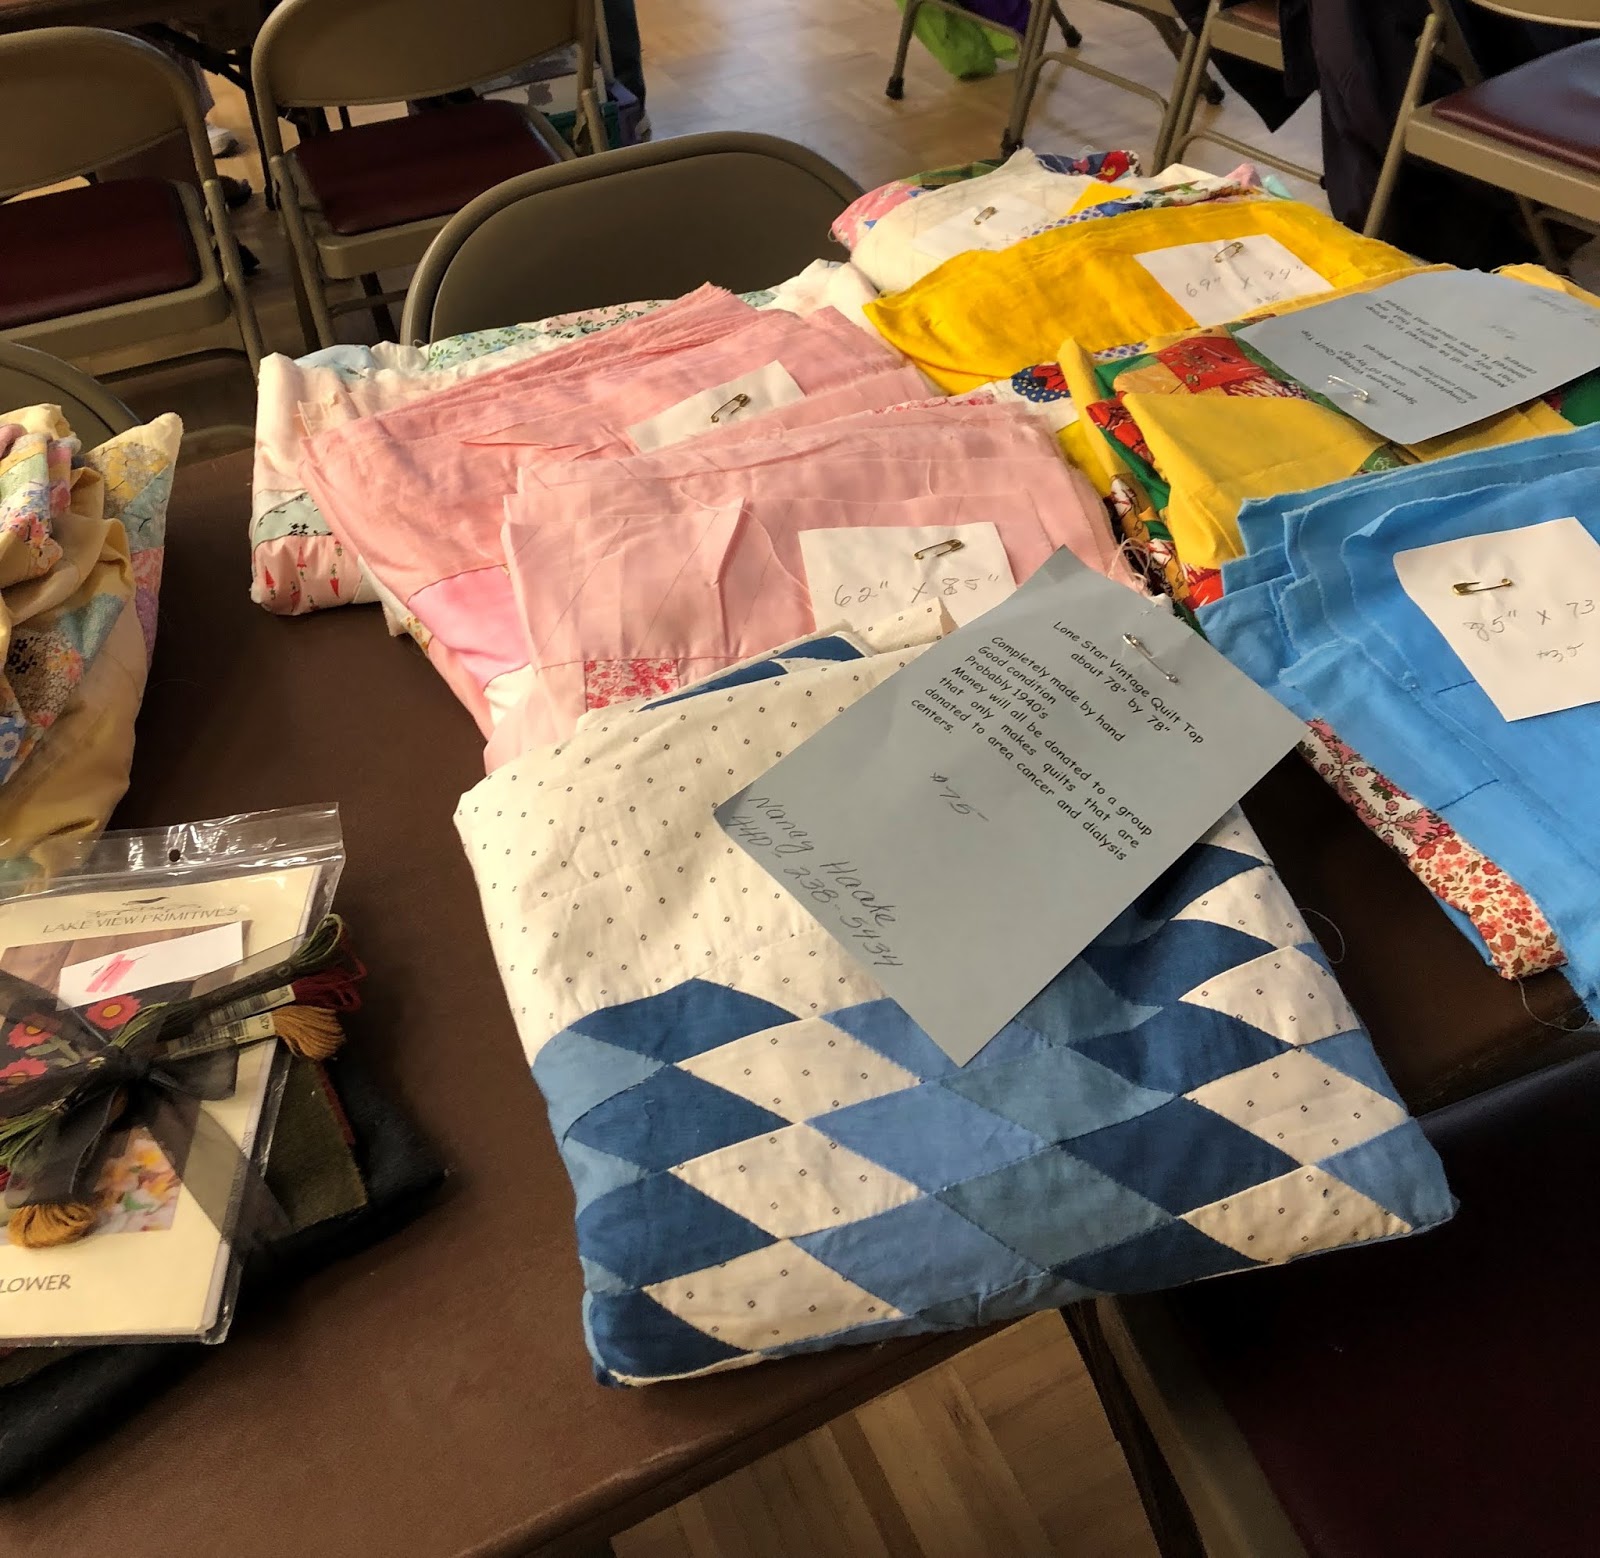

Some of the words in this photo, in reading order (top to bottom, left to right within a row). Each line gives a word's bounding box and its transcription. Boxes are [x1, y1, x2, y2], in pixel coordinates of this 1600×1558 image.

[1365, 305, 1388, 320] group
[1375, 302, 1390, 312] are
[1384, 300, 1412, 316] dialysis
[1393, 314, 1411, 325] that
[1413, 316, 1430, 326] and
[1301, 330, 1314, 341] Top
[1404, 330, 1438, 349] donated
[1415, 327, 1439, 341] quilts
[1432, 327, 1458, 341] cancer
[1315, 341, 1336, 356] Quilt
[1363, 344, 1392, 361] pieced
[1443, 342, 1469, 357] makes
[1459, 341, 1479, 353] area
[1336, 355, 1364, 375] Vintage
[1356, 358, 1367, 367] by
[1450, 356, 1463, 364] all
[1462, 363, 1478, 372] will
[1475, 360, 1492, 371] only
[1390, 360, 1423, 377] machine
[1418, 365, 1456, 386] condition
[1492, 360, 1527, 379] donated
[1365, 374, 1391, 389] Theme
[1382, 374, 1406, 387] about
[1479, 372, 1507, 388] Money
[1497, 373, 1516, 384] that
[1393, 388, 1418, 405] Sport
[1422, 377, 1468, 405] Completely
[1454, 386, 1478, 400] Good
[942, 573, 999, 596] 85"
[977, 646, 1008, 667] Good
[1006, 665, 1057, 706] condition
[1052, 620, 1081, 643] Lone
[1080, 640, 1109, 662] Star
[1109, 658, 1151, 698] Vintage
[1150, 696, 1182, 724] Quilt
[1185, 722, 1205, 745] Top
[965, 655, 1013, 692] Probably
[1011, 688, 1049, 720] 1940's
[991, 636, 1051, 679] Completely
[1050, 676, 1081, 704] made
[1079, 700, 1097, 718] by
[1095, 714, 1127, 742] hand
[1070, 651, 1104, 679] about
[1104, 676, 1128, 695] 78"
[1127, 699, 1144, 716] by
[1146, 715, 1172, 734] 78"
[951, 666, 988, 695] Money
[989, 692, 1011, 710] will
[1010, 708, 1028, 723] all
[1026, 721, 1043, 739] be
[1044, 738, 1092, 781] donated
[1092, 780, 1106, 796] to
[1107, 795, 1118, 806] a
[1115, 804, 1153, 837] group
[939, 676, 964, 697] that
[970, 698, 994, 720] only
[1000, 722, 1037, 757] makes
[1042, 761, 1076, 792] quilts
[1084, 796, 1111, 822] that
[1117, 828, 1140, 849] are
[924, 687, 971, 723] donated
[971, 721, 986, 735] to
[987, 735, 1014, 761] area
[1016, 761, 1055, 796] cancer
[1056, 798, 1082, 820] and
[1082, 819, 1128, 861] dialysis
[42, 919, 92, 934] LAKE
[99, 914, 140, 928] VIEW
[140, 906, 240, 924] PRIMITIVES
